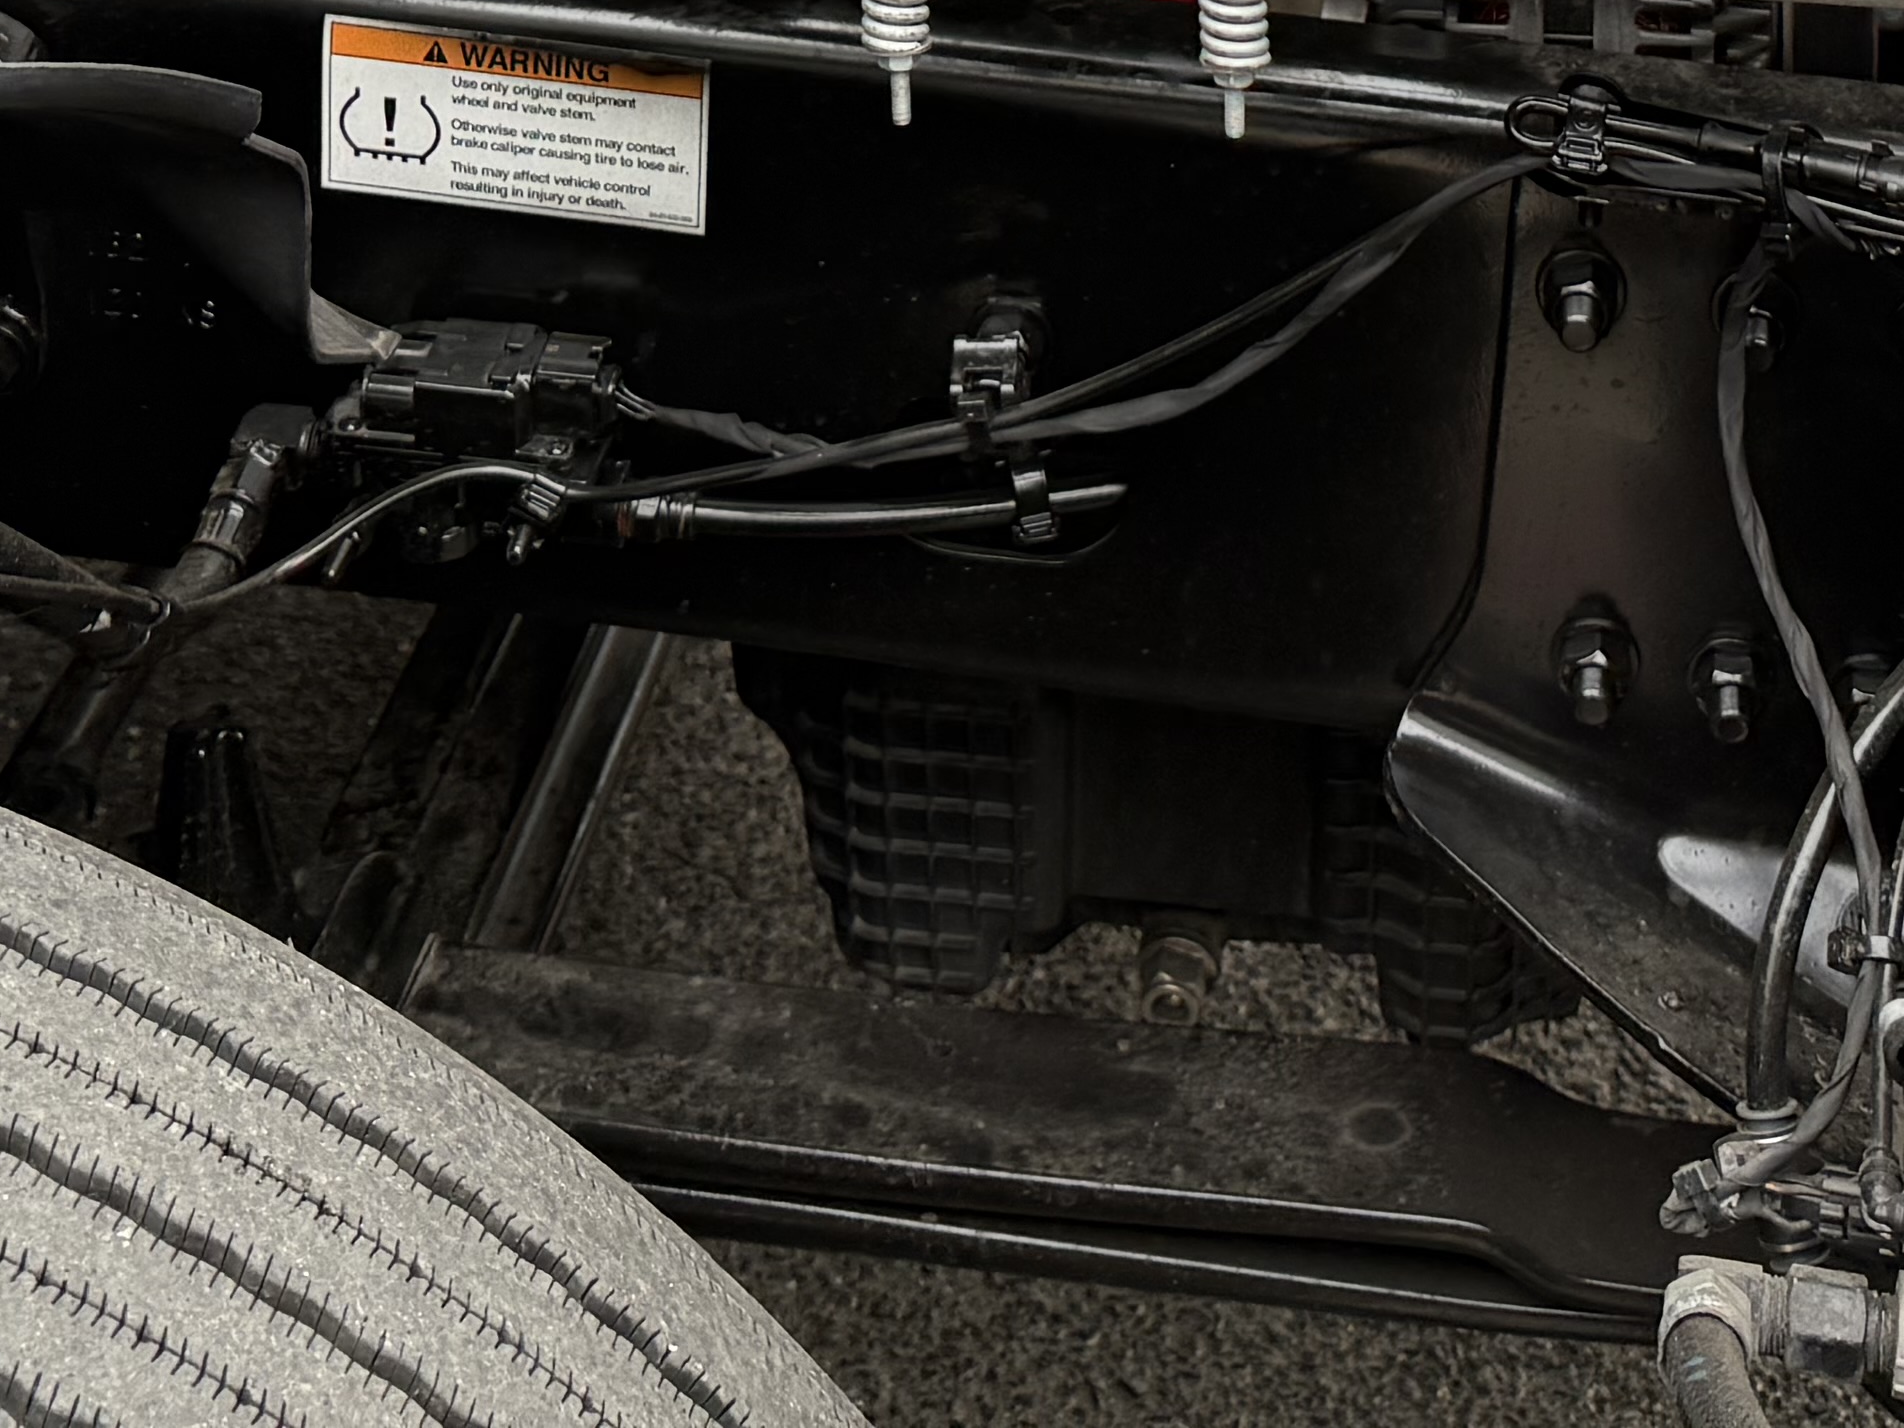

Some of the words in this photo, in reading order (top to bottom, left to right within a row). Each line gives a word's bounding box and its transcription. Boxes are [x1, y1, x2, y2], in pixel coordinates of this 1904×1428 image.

[460, 41, 610, 83] WARNING
[451, 95, 489, 108] wheel
[492, 100, 518, 111] and
[522, 104, 557, 117] valve
[560, 108, 596, 122] stem.
[452, 75, 478, 89] Use
[481, 80, 509, 96] only
[512, 85, 563, 102] original
[566, 92, 637, 110] equipment
[451, 118, 518, 137] Otherwise
[521, 127, 556, 142] valve
[559, 132, 592, 146] stem
[595, 138, 624, 153] may
[626, 142, 676, 158] contact
[451, 135, 488, 150] brake
[490, 141, 536, 157] caliper
[539, 147, 591, 165] causing
[595, 152, 617, 166] tire
[620, 156, 634, 168] to
[637, 158, 665, 172] lose
[668, 162, 690, 175] air.
[450, 179, 508, 199] resulting
[511, 186, 524, 198] in
[527, 189, 565, 205] injury
[568, 194, 582, 205] or
[585, 196, 626, 211] death.
[451, 160, 478, 176] This
[481, 167, 510, 182] may
[513, 171, 550, 185] affect
[554, 175, 601, 191] vehicle
[603, 182, 651, 197] control
